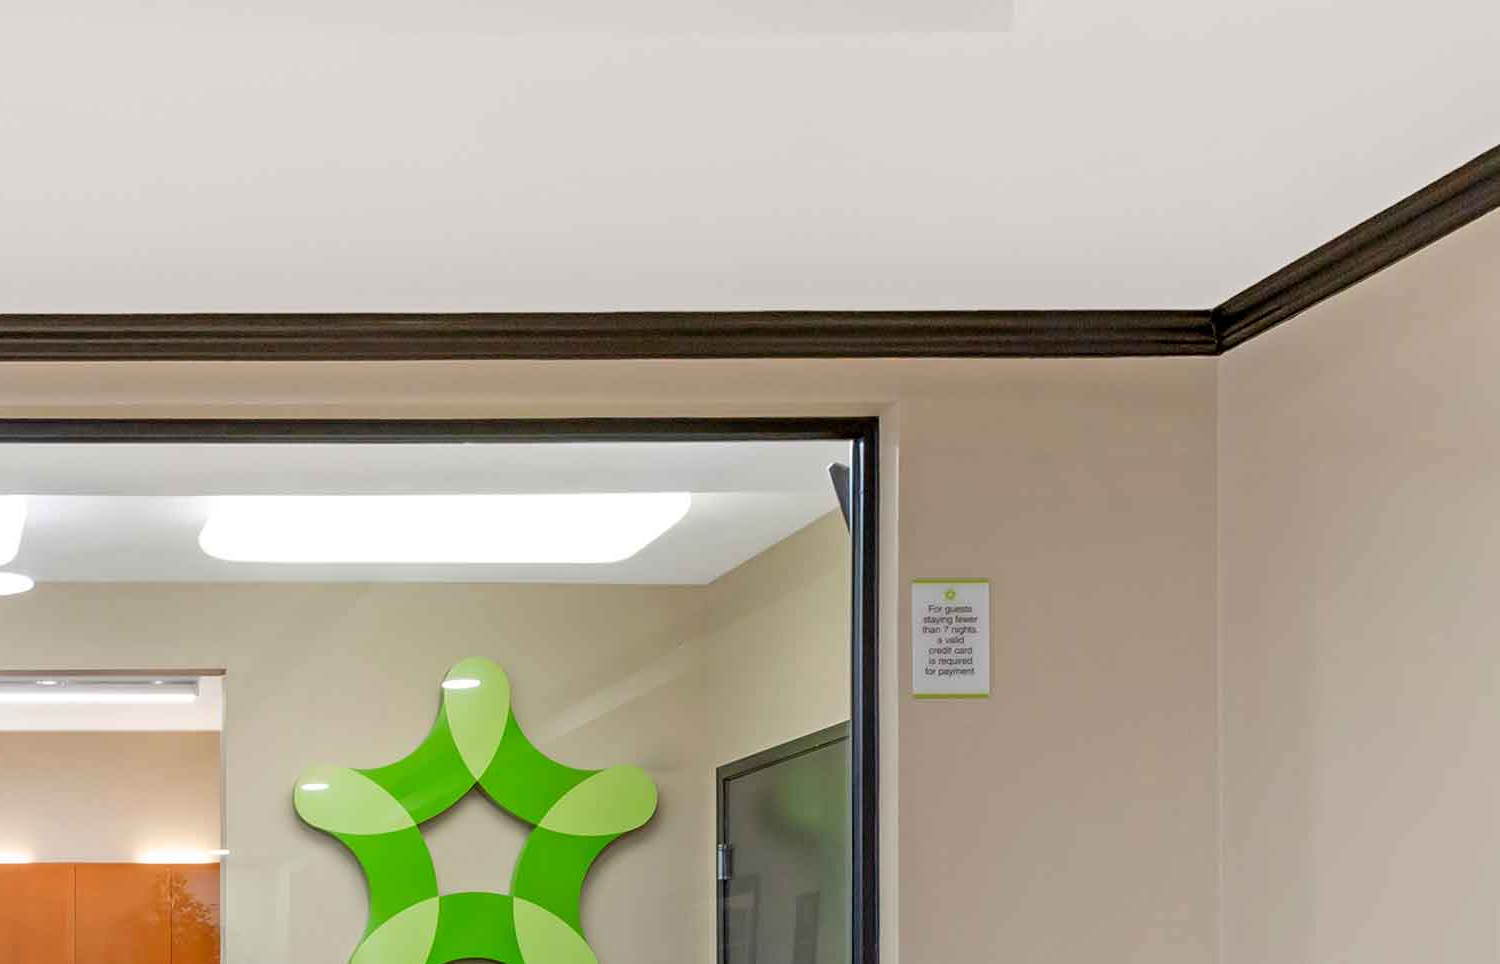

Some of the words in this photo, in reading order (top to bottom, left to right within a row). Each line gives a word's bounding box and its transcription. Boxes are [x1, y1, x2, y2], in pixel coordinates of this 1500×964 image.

[928, 604, 942, 613] For
[944, 605, 973, 615] guests
[923, 616, 954, 625] staying
[922, 626, 941, 634] than
[943, 625, 950, 634] 7
[951, 625, 977, 635] nights
[944, 636, 965, 644] valid
[928, 646, 954, 655] credit
[954, 646, 973, 655] card
[928, 657, 936, 665] is
[938, 657, 973, 666] required
[925, 667, 936, 675] for
[938, 667, 975, 677] payment
